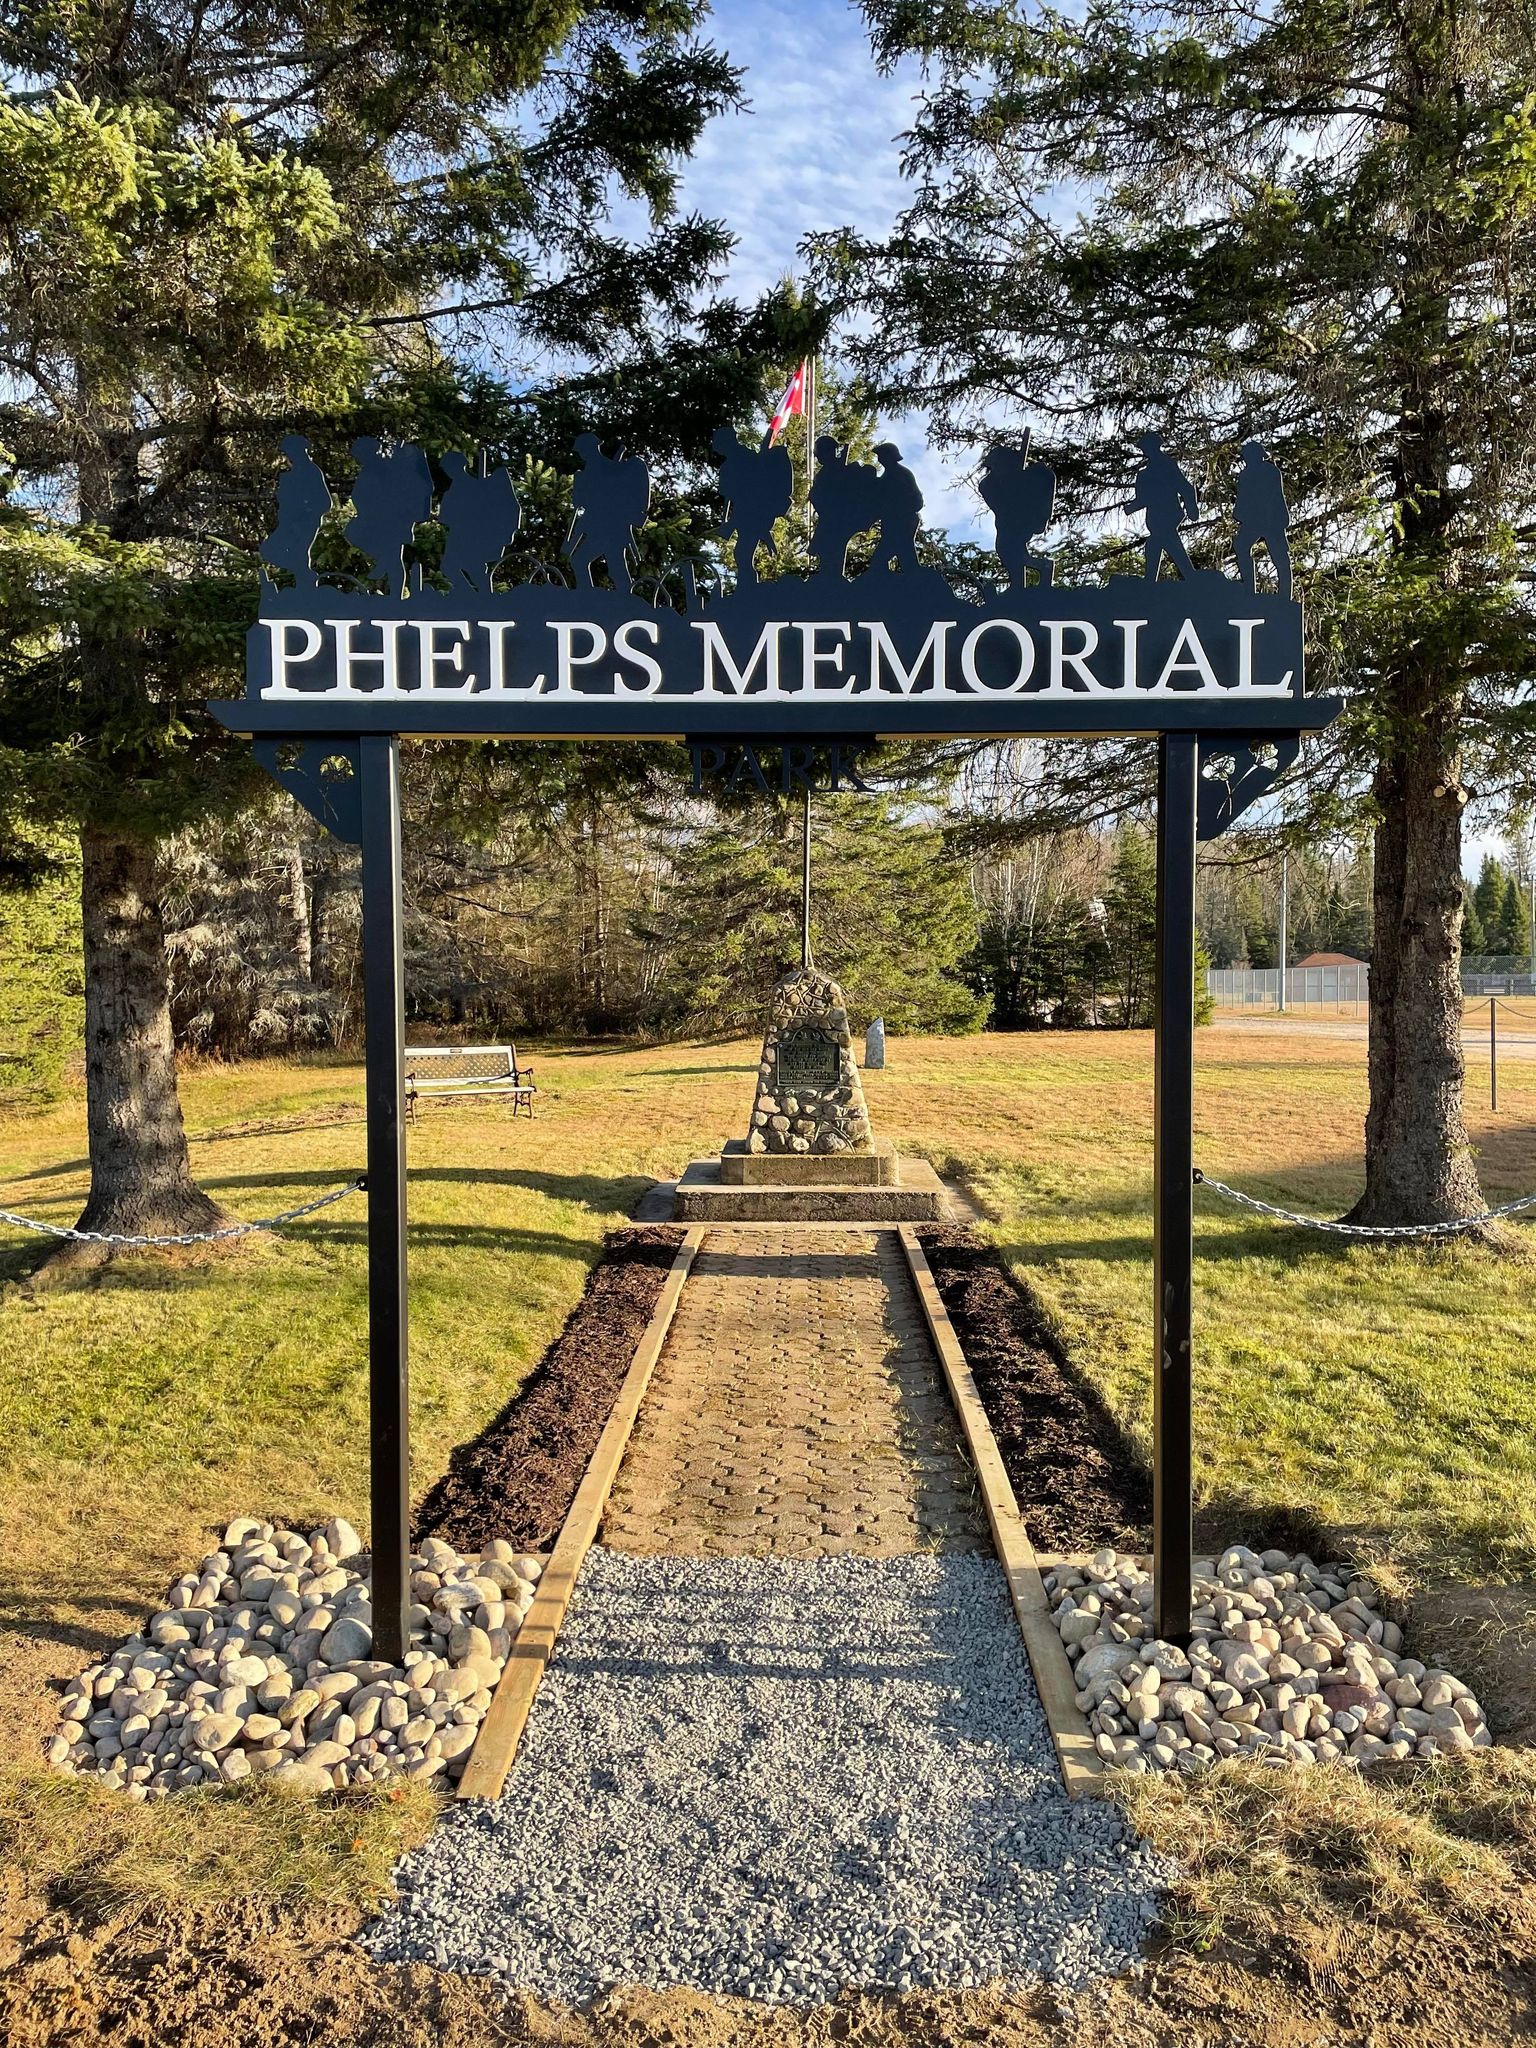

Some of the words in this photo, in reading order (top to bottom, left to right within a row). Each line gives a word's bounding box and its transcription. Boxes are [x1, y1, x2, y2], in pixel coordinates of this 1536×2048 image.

[258, 618, 664, 699] PHELPS
[690, 617, 1294, 700] MEMORIAL
[689, 742, 876, 793] PARK
